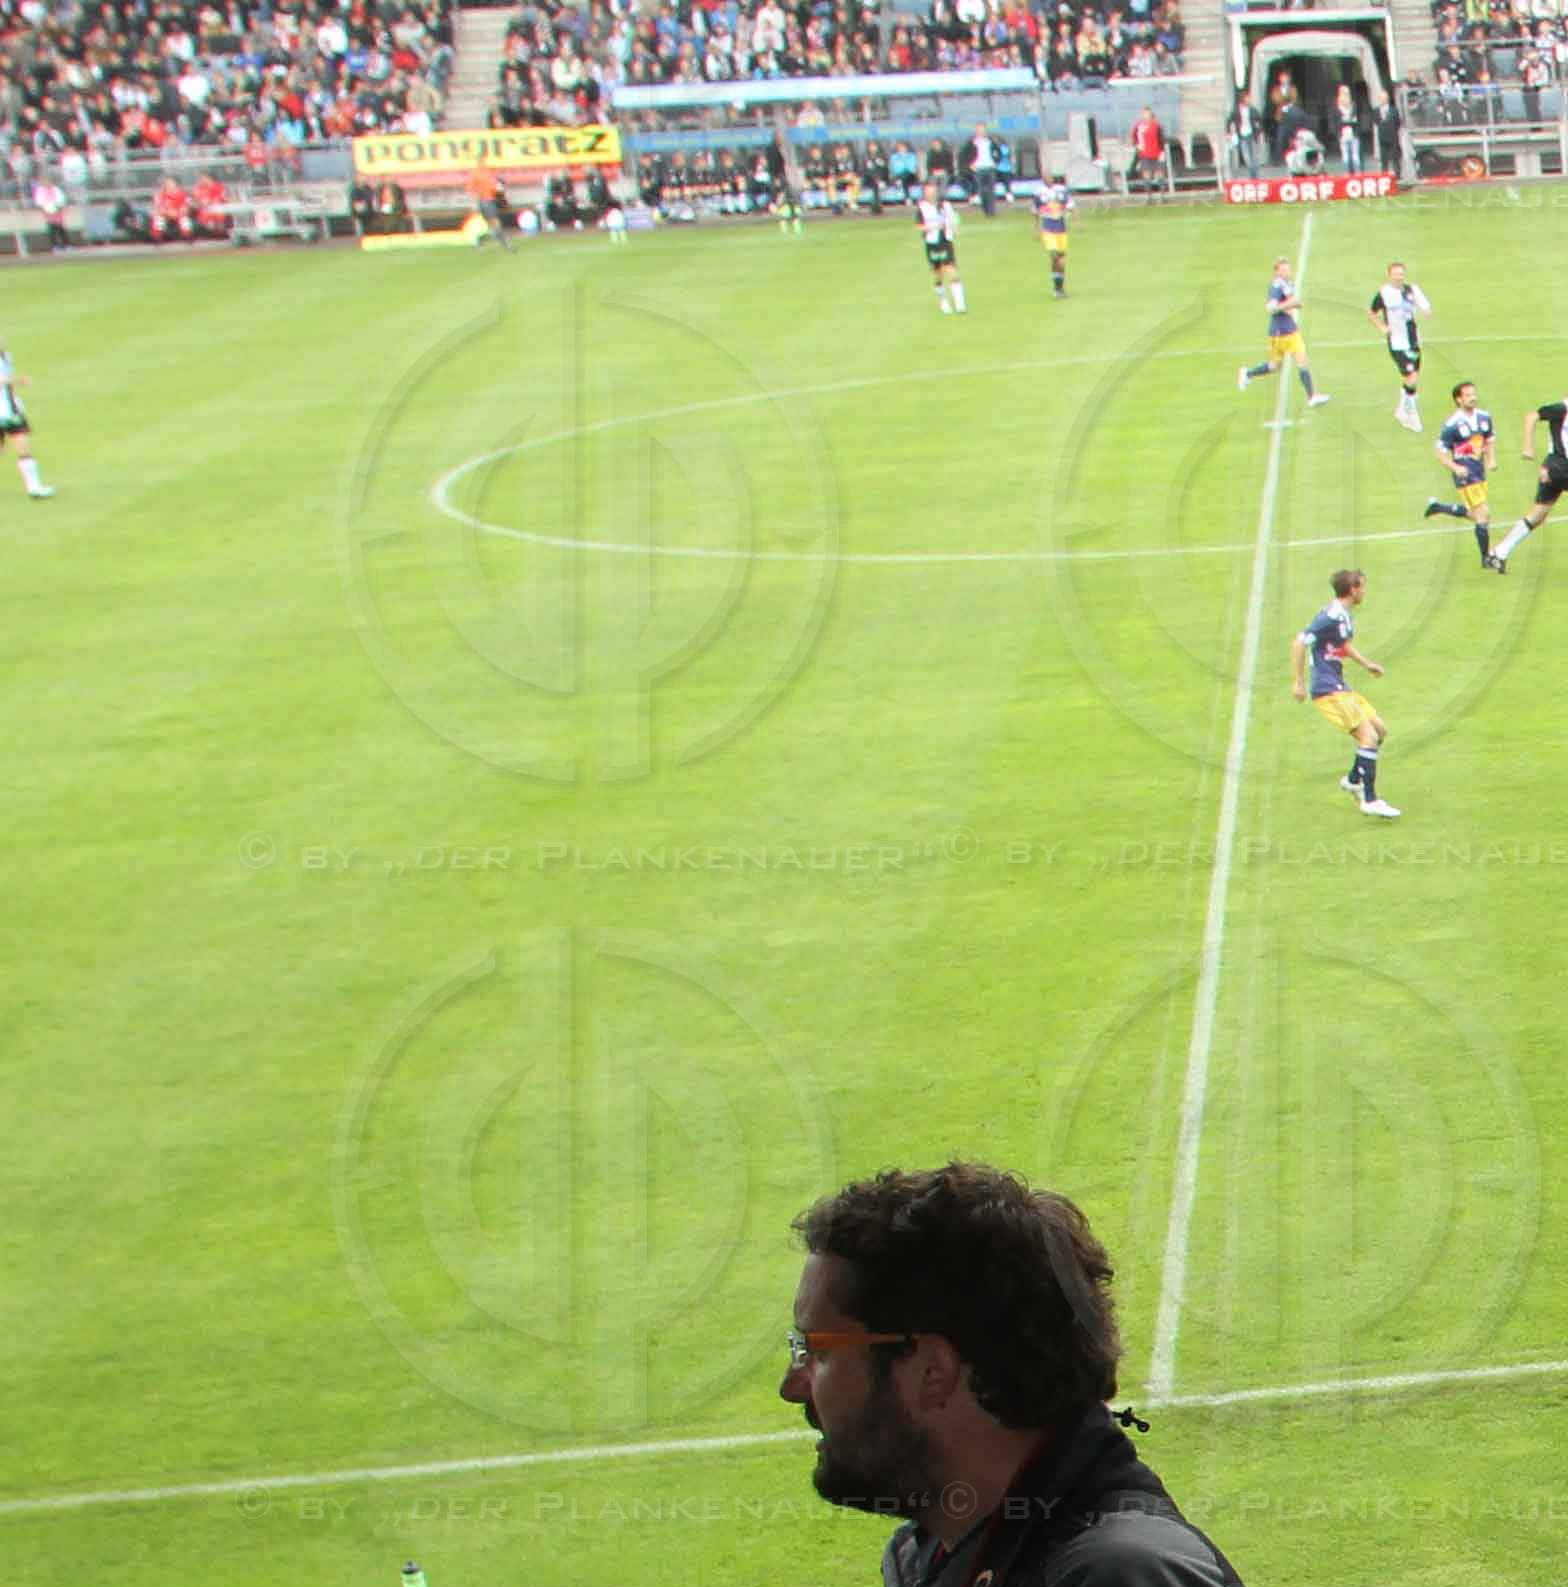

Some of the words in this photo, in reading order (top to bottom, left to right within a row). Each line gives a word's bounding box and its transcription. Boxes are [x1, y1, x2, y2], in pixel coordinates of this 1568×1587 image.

[1230, 183, 1269, 202] ORF
[1279, 181, 1335, 201] ORF
[1345, 176, 1392, 198] ORF
